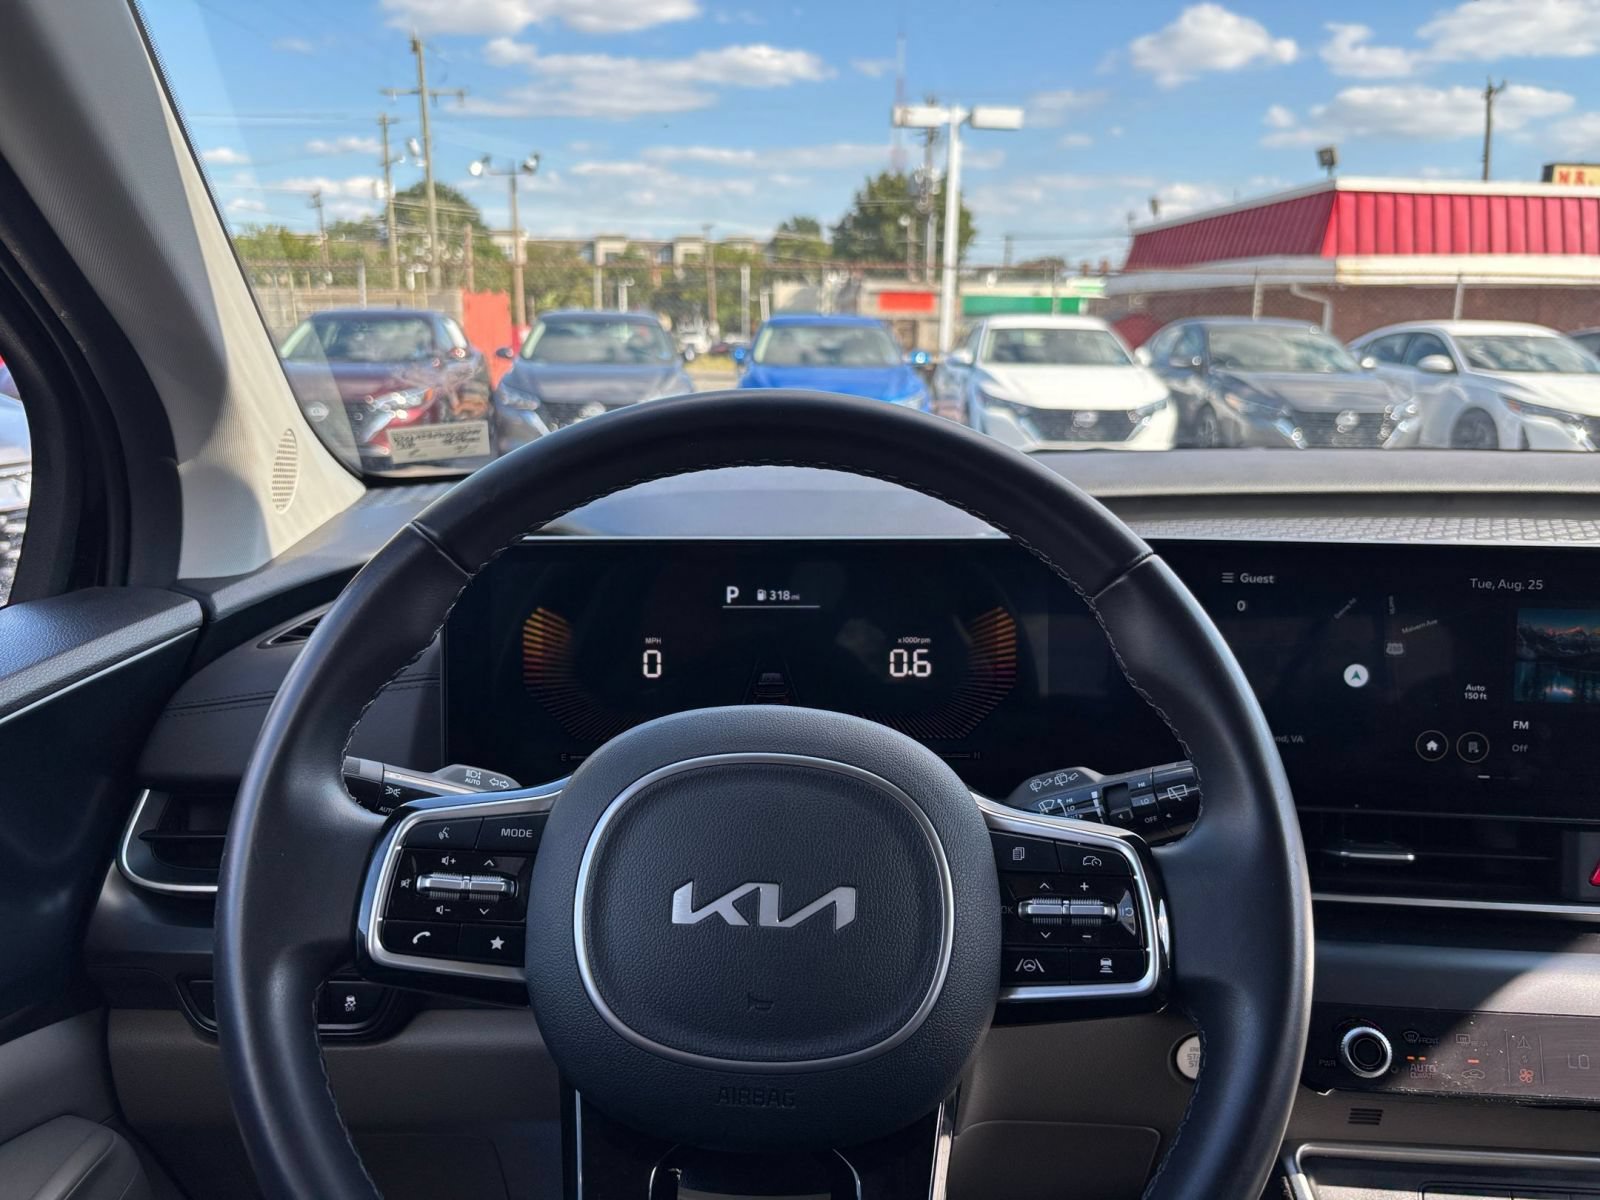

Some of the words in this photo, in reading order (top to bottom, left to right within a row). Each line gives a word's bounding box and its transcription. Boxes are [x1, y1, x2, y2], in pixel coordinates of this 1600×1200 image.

[1240, 572, 1275, 584] Guest
[1470, 578, 1495, 590] Tue,
[1497, 579, 1525, 592] Aug.
[1527, 579, 1543, 590] 25
[726, 586, 740, 604] P
[769, 590, 790, 601] 318
[1236, 600, 1246, 612] 0
[643, 649, 661, 678] 0
[890, 648, 931, 677] 0.6
[1465, 684, 1486, 692] Auto
[1464, 692, 1478, 700] 150
[1479, 692, 1487, 700] ft
[1512, 720, 1530, 730] FM
[1290, 735, 1304, 743] VA
[1511, 743, 1529, 752] Off
[465, 778, 480, 786] AUTO
[1140, 798, 1150, 806] LO
[379, 805, 395, 814] AUT
[1144, 815, 1158, 824] OFF
[501, 827, 533, 839] MODE
[672, 880, 857, 931] KIA
[1318, 1058, 1337, 1068] PWR
[1410, 1063, 1437, 1073] AUTO
[718, 1086, 796, 1107] AIRBAG
